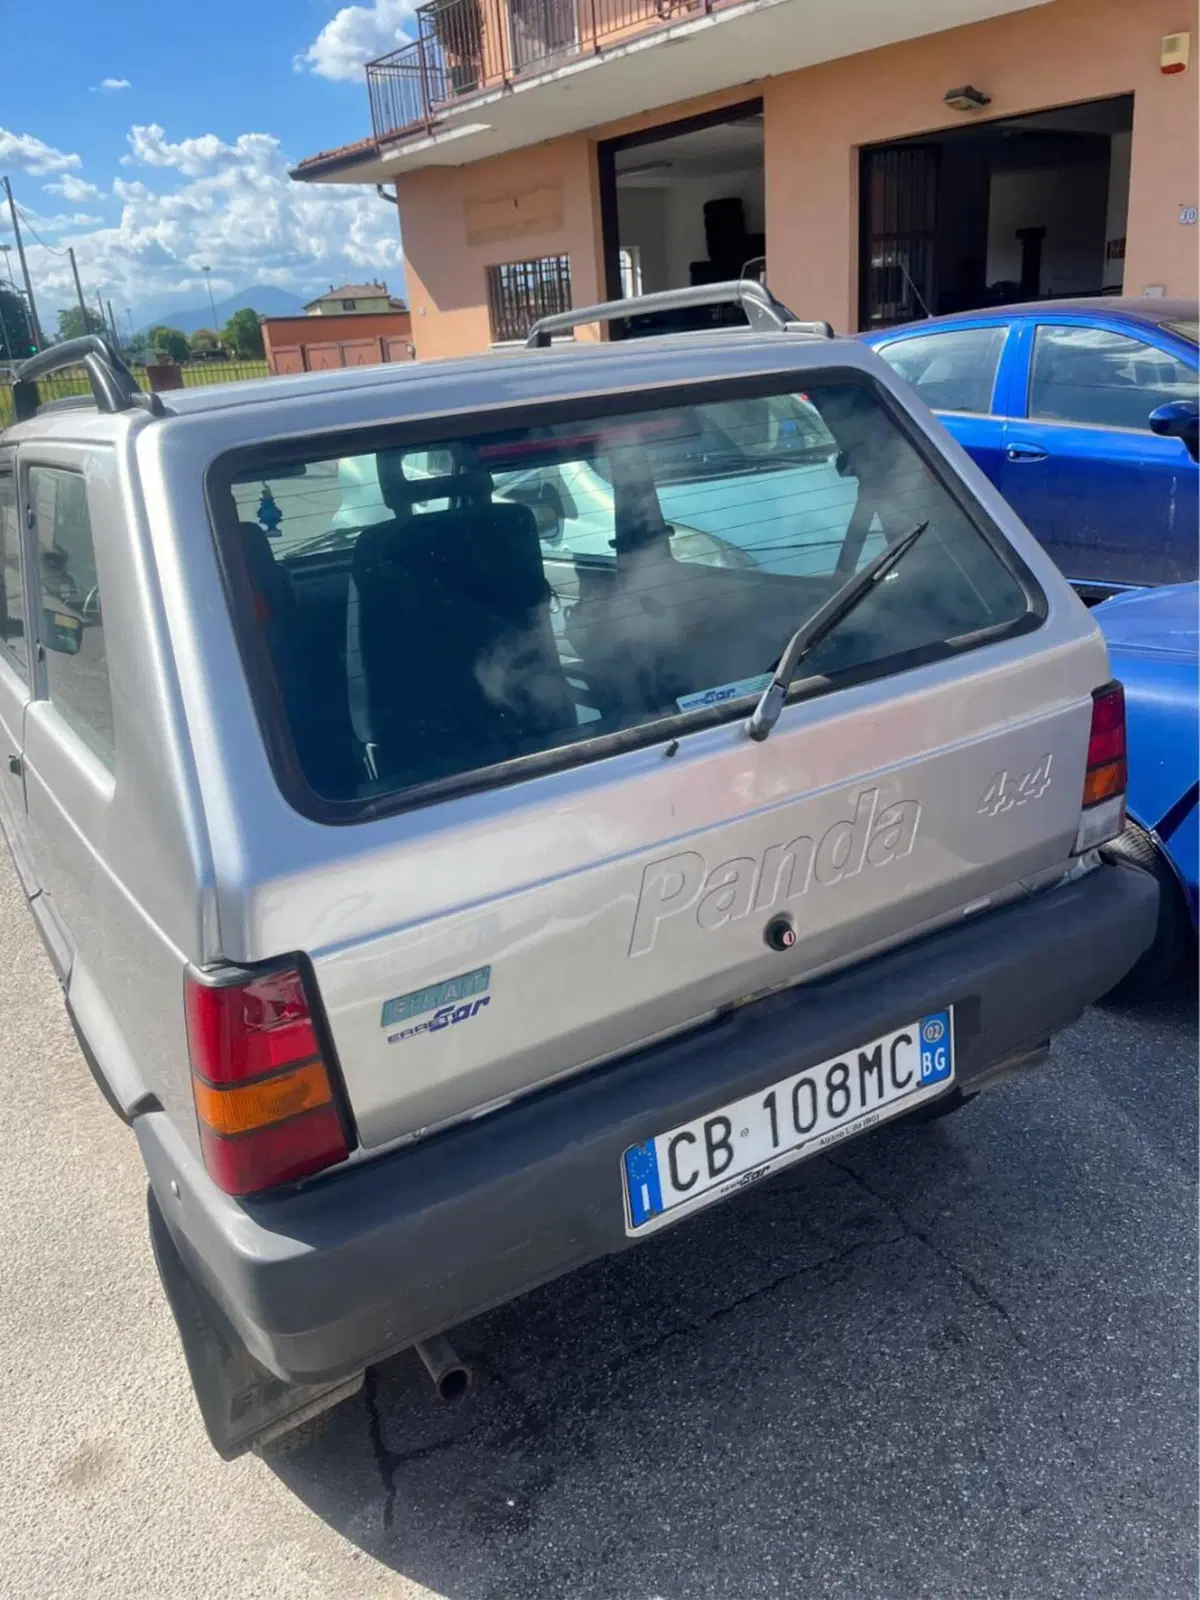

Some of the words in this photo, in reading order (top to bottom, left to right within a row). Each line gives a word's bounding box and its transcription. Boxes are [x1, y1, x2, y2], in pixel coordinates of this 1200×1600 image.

[977, 754, 1053, 818] 4x4
[628, 786, 923, 958] Panda
[641, 1182, 650, 1212] I
[922, 1047, 946, 1077] BG
